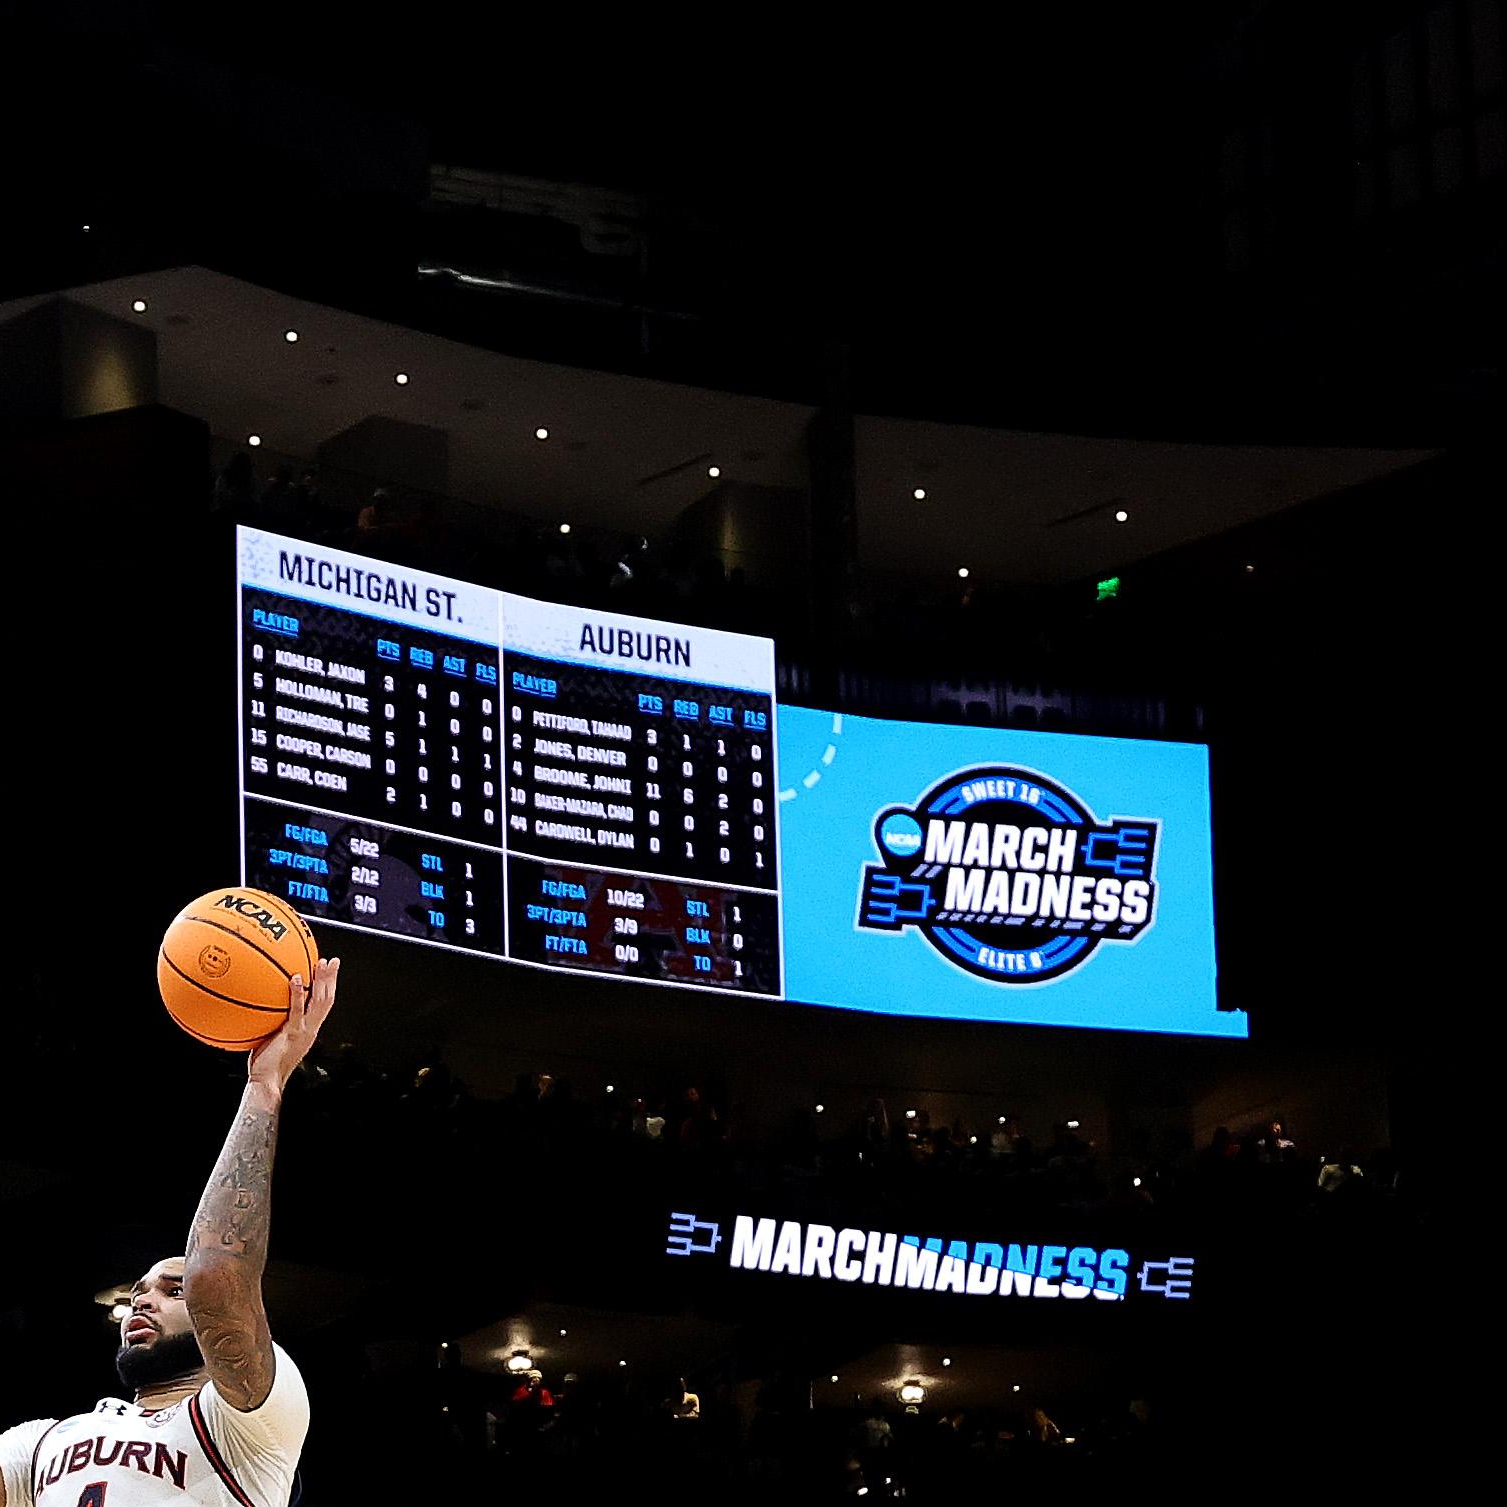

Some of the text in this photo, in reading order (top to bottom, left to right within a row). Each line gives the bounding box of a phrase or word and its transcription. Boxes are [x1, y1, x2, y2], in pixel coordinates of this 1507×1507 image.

[279, 551, 463, 623] MICHIGAN ST.
[253, 609, 496, 681] PLAYER PTS REB AST FLS
[580, 623, 691, 667] AUBURN
[253, 644, 263, 660] 0
[276, 650, 325, 677] KOHLER,
[384, 676, 394, 691] 3
[417, 684, 427, 699] 4
[253, 673, 263, 689] 5
[276, 678, 344, 709] HOLLOMAN,
[385, 704, 394, 720] 0
[419, 711, 426, 727] 1
[512, 671, 767, 726] PLAYER PTS REB AST FLS
[251, 700, 266, 717] 11
[385, 731, 395, 747] 5
[419, 739, 426, 755] 1
[512, 706, 522, 721] 0
[646, 729, 657, 745] 3
[683, 734, 691, 750] 1
[251, 728, 428, 782] 15 COOPER, CARSON 0 0
[512, 733, 693, 778] 2 JONES, DENVER 0 0
[251, 756, 268, 773] 55
[386, 786, 396, 802] 2
[419, 794, 428, 810] 1
[512, 761, 522, 776] 4
[646, 783, 661, 799] 11
[684, 788, 694, 805] 6
[962, 780, 1040, 804] SWEET 16
[511, 787, 526, 805] 10
[649, 810, 659, 826] 0
[684, 815, 694, 832] 0
[350, 837, 379, 859] 5/22
[510, 814, 694, 859] 44 CARDWELL, DYLAN 0 1
[924, 819, 1077, 873] MARCH
[422, 854, 473, 880] STL 1
[354, 895, 377, 914] 3/3
[421, 881, 473, 907] BLK 1
[607, 889, 645, 910] 10/22
[686, 900, 741, 923] STL 1
[943, 866, 1150, 924] MADNESS
[215, 895, 288, 941] NCAA
[428, 911, 476, 936] TO 3
[614, 918, 638, 935] 3/9
[686, 927, 743, 951] BLK 0
[615, 945, 639, 963] 0/0
[694, 956, 743, 977] TO 1
[978, 948, 1025, 972] ELITE
[730, 1214, 1130, 1301] MARCHMADNESS
